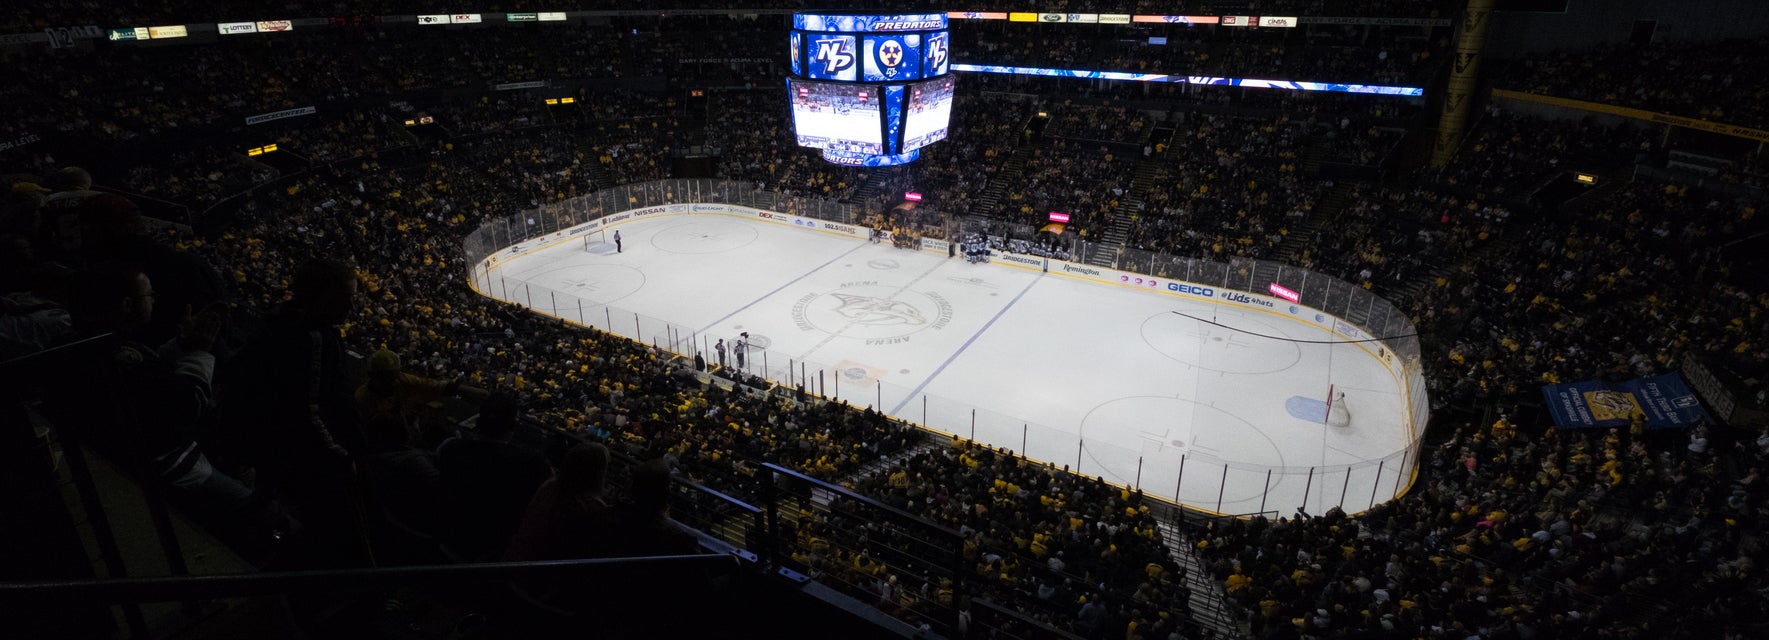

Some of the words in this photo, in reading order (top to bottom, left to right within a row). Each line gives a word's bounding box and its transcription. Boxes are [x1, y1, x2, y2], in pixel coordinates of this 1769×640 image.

[874, 20, 941, 30] PREDATORS
[634, 207, 666, 217] NISSAN
[758, 211, 774, 219] DEX
[1003, 254, 1041, 266] BRIDGESTONE
[1063, 263, 1100, 276] Remington
[1167, 282, 1214, 297] GEICO
[1270, 284, 1299, 301] NISSAN
